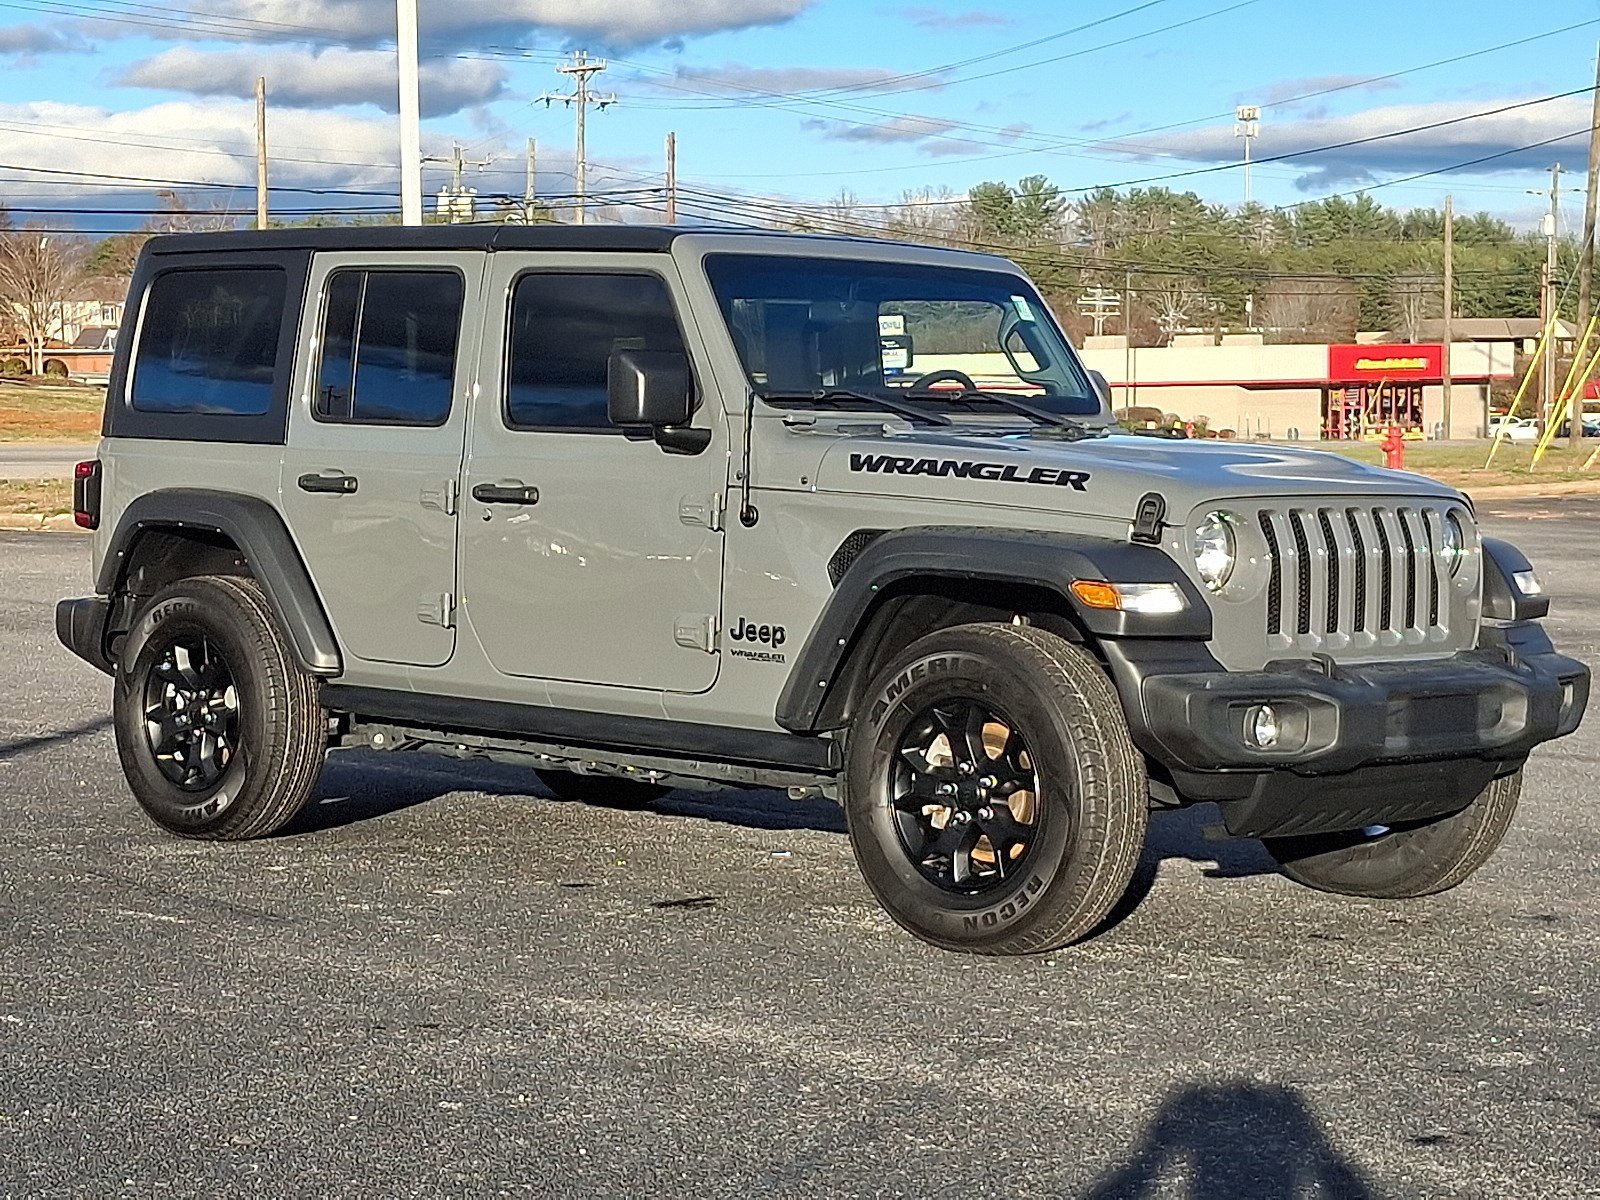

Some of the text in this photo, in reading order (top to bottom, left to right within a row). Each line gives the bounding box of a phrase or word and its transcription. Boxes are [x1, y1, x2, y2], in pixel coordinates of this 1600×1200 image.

[850, 453, 1091, 491] WRANGLER
[729, 616, 787, 649] Jeep
[962, 874, 1044, 932] RECON
